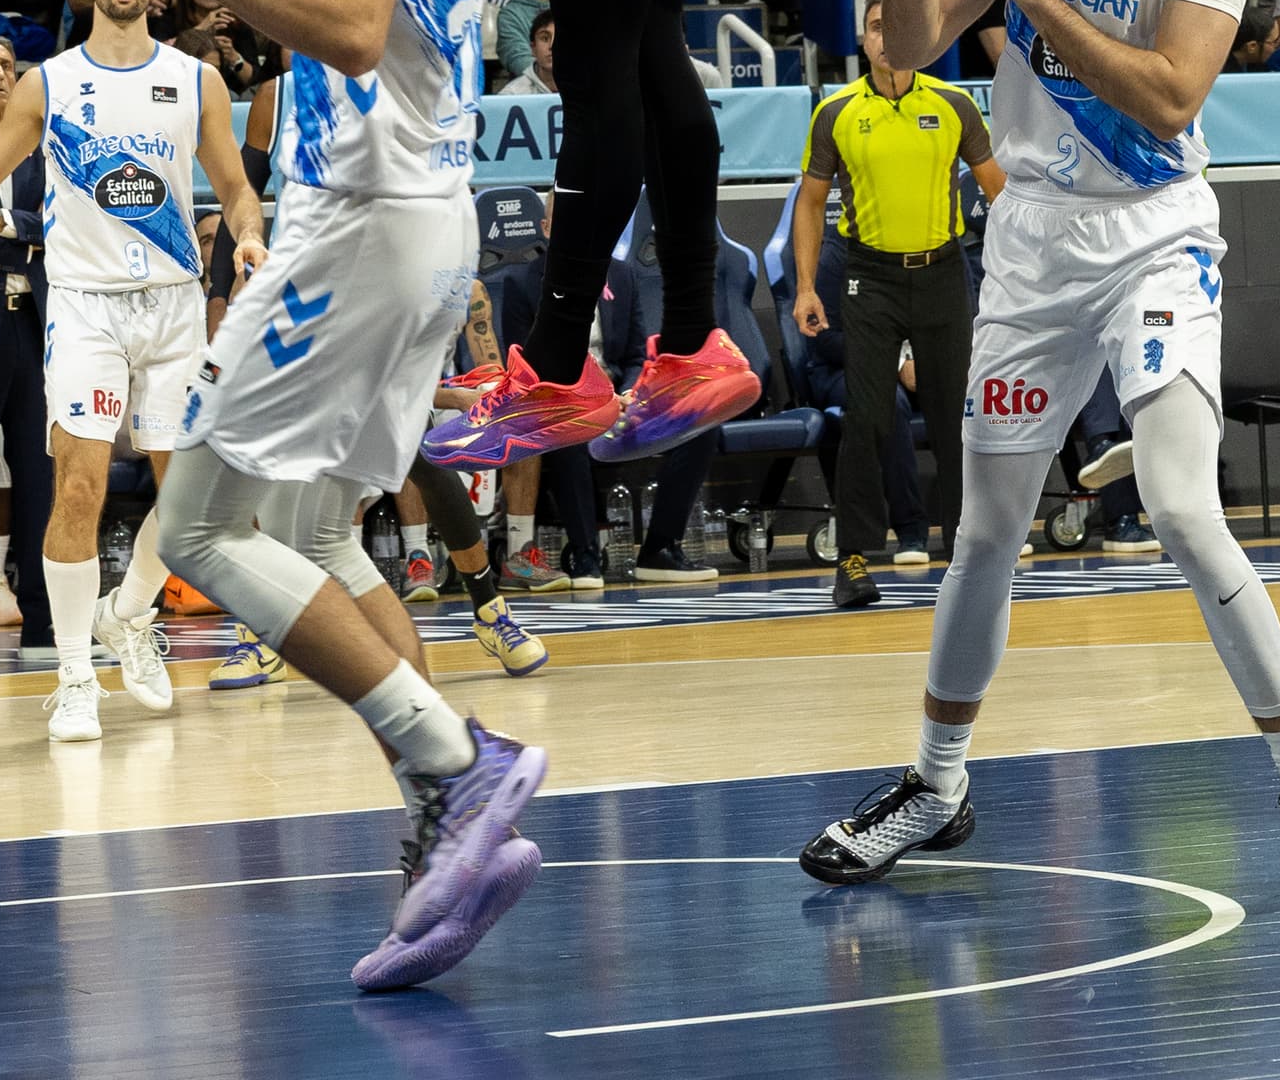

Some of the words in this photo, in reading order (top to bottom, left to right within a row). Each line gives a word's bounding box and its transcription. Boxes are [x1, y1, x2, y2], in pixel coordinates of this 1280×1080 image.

[79, 131, 176, 166] BREOGÁN
[1046, 133, 1081, 189] 2
[106, 178, 156, 192] Estrella
[108, 191, 154, 206] Galicia
[497, 202, 522, 214] OMP
[503, 220, 534, 229] andorra
[504, 228, 537, 238] telecom
[124, 240, 151, 281] 9
[1145, 314, 1167, 326] acb
[982, 377, 1049, 417] Río
